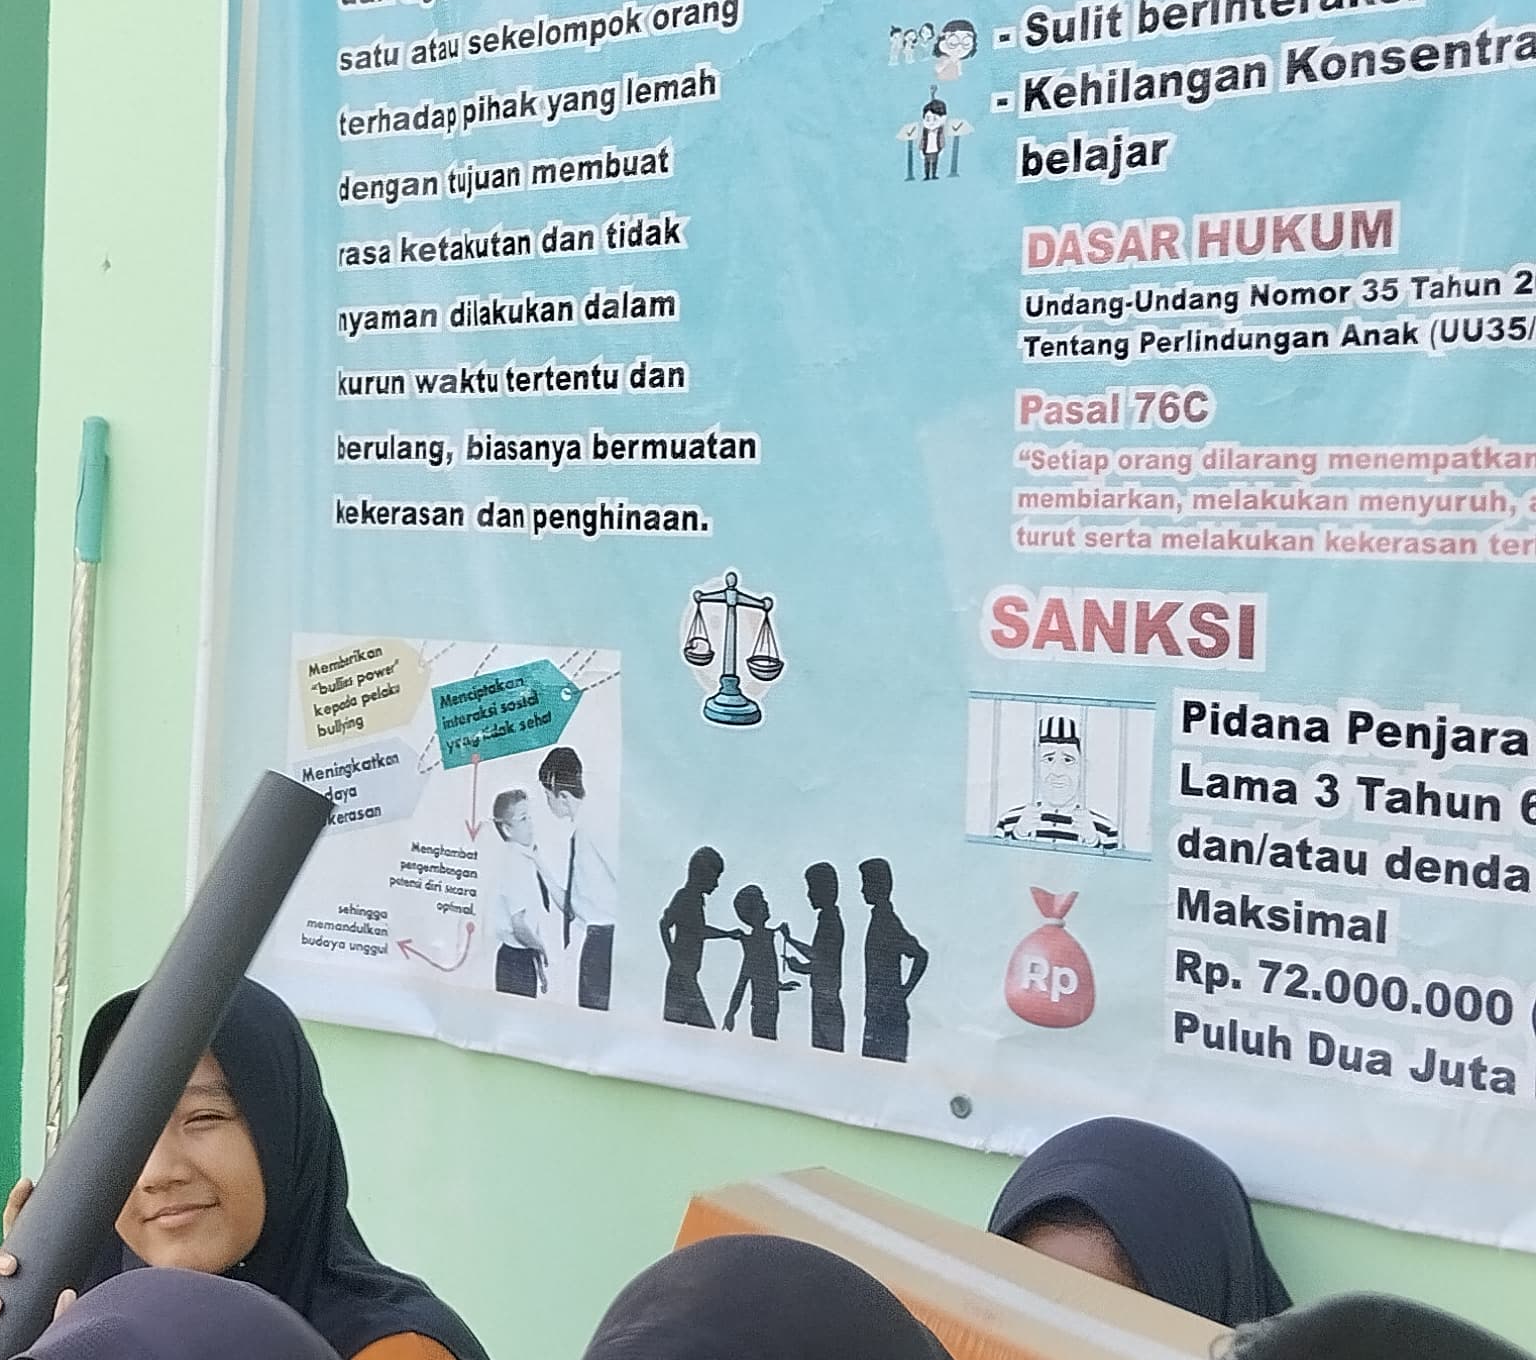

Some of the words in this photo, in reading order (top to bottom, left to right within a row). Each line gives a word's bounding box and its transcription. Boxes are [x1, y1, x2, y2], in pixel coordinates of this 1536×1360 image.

[339, 45, 399, 72] satu
[411, 34, 459, 65] atau
[467, 9, 641, 56] sekelompok
[1024, 4, 1122, 48] Sulit
[1023, 55, 1265, 113] Kehilangan
[1284, 28, 1536, 87] Konsentra
[339, 99, 457, 137] terhadap
[462, 91, 538, 129] pihak
[547, 83, 615, 123] yang
[627, 69, 716, 106] lemah
[339, 175, 438, 206] dengan
[448, 166, 520, 198] tujuan
[532, 145, 669, 185] membuat
[1021, 134, 1169, 180] belajar
[338, 244, 391, 268] rasa
[400, 230, 531, 263] ketakutan
[542, 225, 594, 253] dan
[606, 216, 682, 250] tidak
[1027, 223, 1181, 269] DASAR
[1197, 208, 1394, 259] HUKUM
[338, 308, 437, 337] nyaman
[450, 297, 574, 328] dilakukan
[585, 291, 676, 321] dalam
[1025, 287, 1239, 319] Undang-Undang
[1250, 283, 1352, 309] Nomor
[1361, 277, 1399, 303] 35
[1411, 273, 1501, 300] Tahun
[1024, 334, 1129, 359] Tentang
[1140, 324, 1330, 356] Perlindungan
[1340, 321, 1419, 348] Anak
[338, 370, 405, 396] kurun
[415, 367, 498, 395] waktu
[506, 365, 619, 393] tertentu
[629, 361, 685, 389] dan
[1020, 391, 1119, 425] Pasal
[1134, 390, 1209, 424] 76C
[337, 434, 454, 467] berulang,
[467, 433, 581, 467] biasanya
[593, 431, 757, 460] bermuatan
[1118, 453, 1192, 476] orang
[1202, 448, 1317, 475] dilarang
[335, 498, 464, 527] kekerasan
[477, 502, 525, 529] dan
[533, 503, 710, 537] penghinaan.
[1018, 487, 1182, 514] membiarkan,
[1192, 487, 1348, 512] melakukan
[1359, 489, 1517, 518] menyuruh,
[1016, 524, 1076, 548] turut
[1084, 529, 1152, 550] serta
[1162, 528, 1314, 554] melakukan
[1325, 530, 1477, 556] kekerasan
[1488, 533, 1536, 556] ter
[990, 594, 1257, 661] SANKSI
[1182, 700, 1330, 744] Pidana
[1347, 710, 1529, 761] Penjara
[301, 751, 400, 785] Meningkatkan
[327, 803, 382, 827] kerasan
[1180, 763, 1298, 806] Lama
[1315, 773, 1340, 808] 3
[1357, 776, 1501, 823] Tahun
[1177, 827, 1367, 876] dan/atau
[1385, 846, 1531, 894] denda
[1177, 888, 1388, 945] Maksimal
[1020, 955, 1079, 1003] Rp
[1176, 949, 1242, 995] Rp.
[1258, 959, 1514, 1027] 72.000.000
[1174, 1010, 1292, 1062] Puluh
[1309, 1030, 1393, 1078] Dua
[1410, 1047, 1517, 1096] Juta
